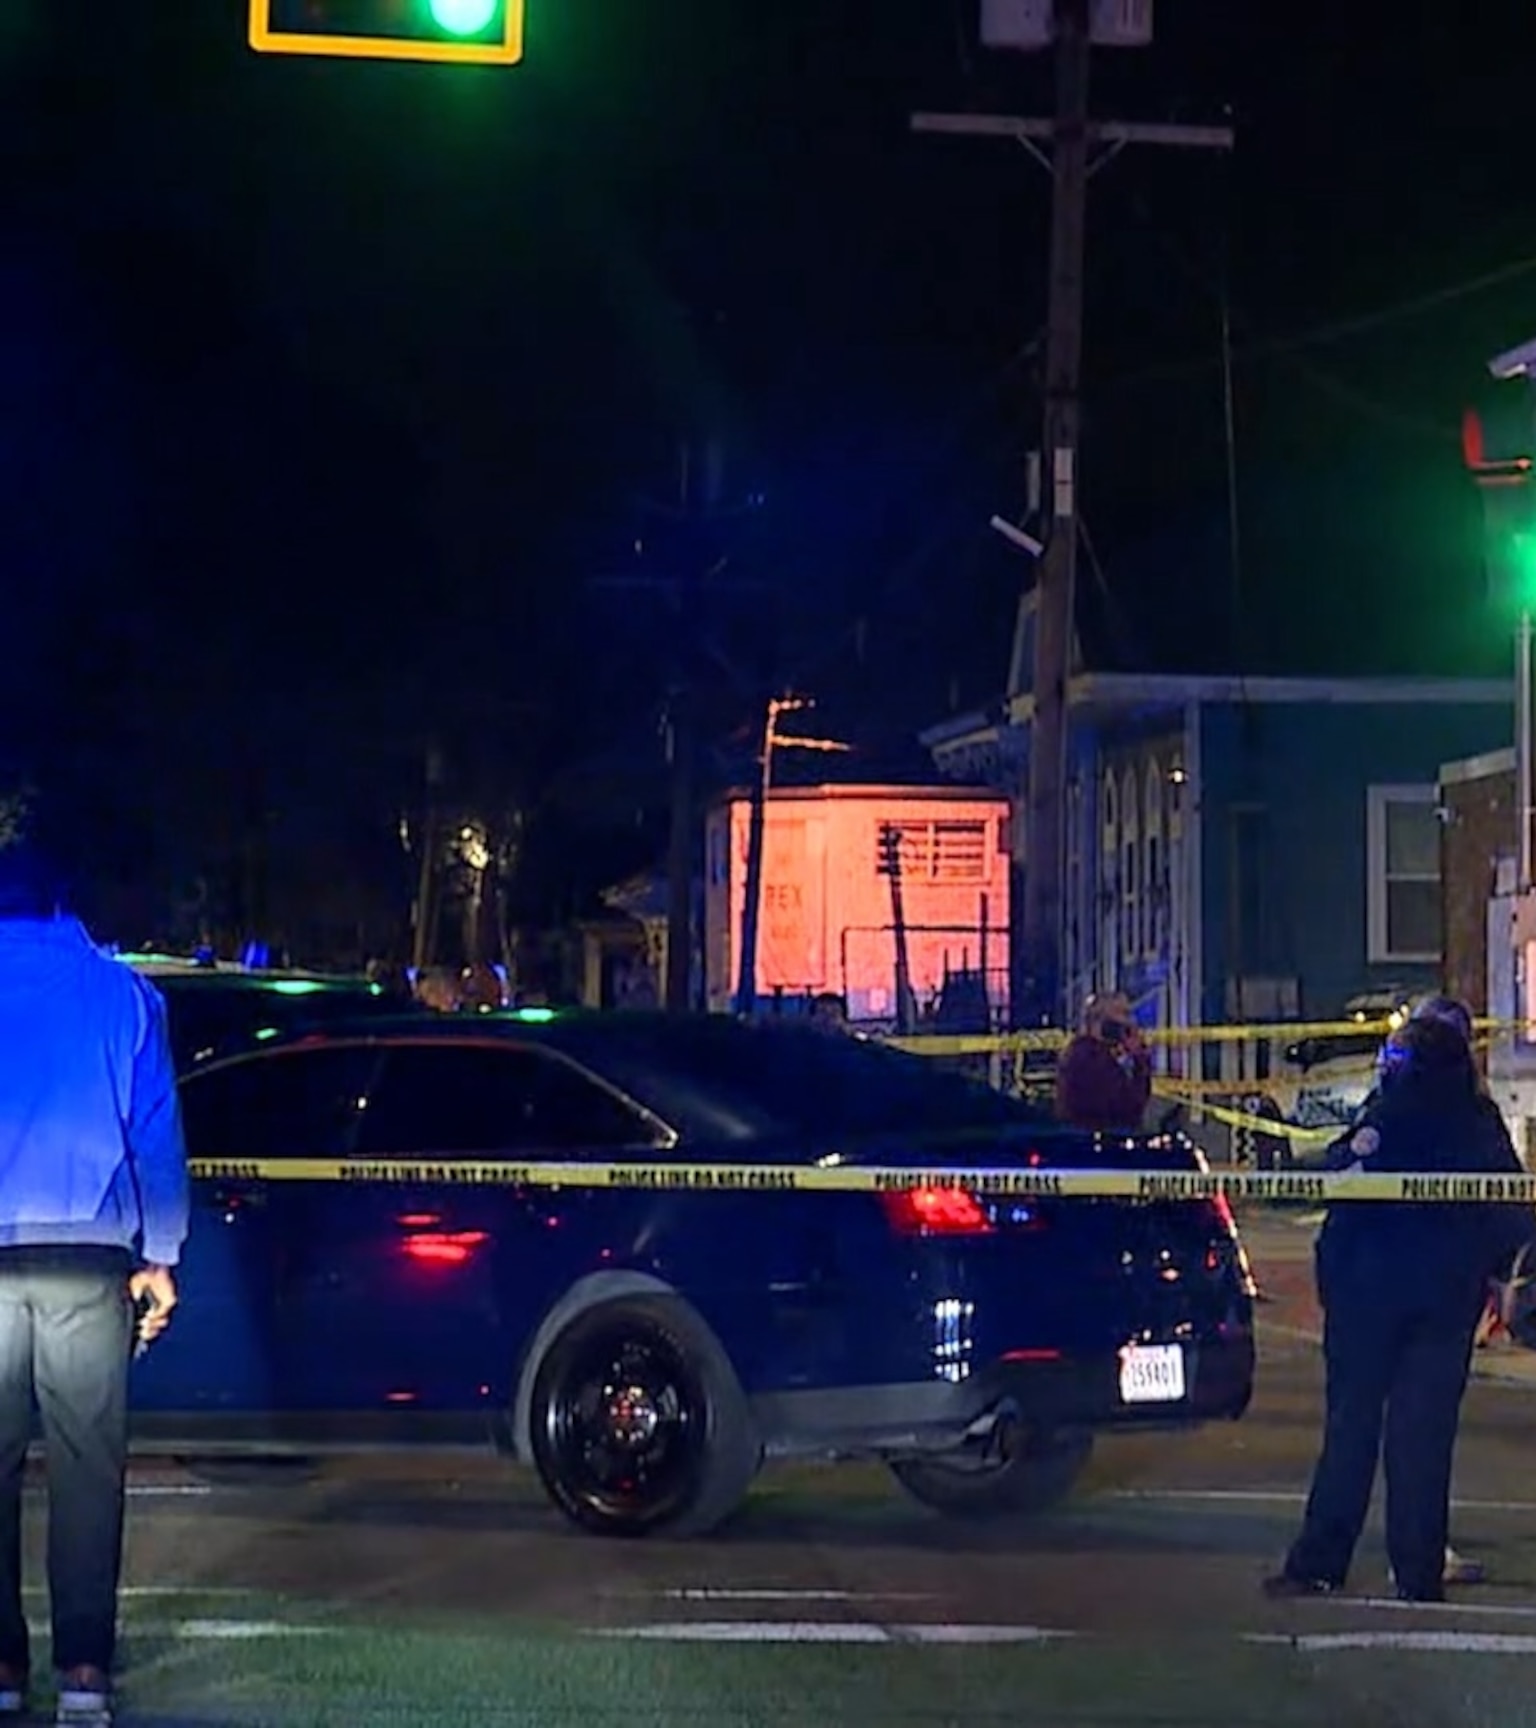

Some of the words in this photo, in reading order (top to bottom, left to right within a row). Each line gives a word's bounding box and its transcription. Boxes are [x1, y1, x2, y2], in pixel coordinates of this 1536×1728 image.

[190, 1163, 207, 1177] OT
[609, 1169, 657, 1185] POLICE
[660, 1169, 690, 1186] LINE
[694, 1170, 713, 1186] DO
[717, 1170, 744, 1187] NOT
[748, 1170, 796, 1187] CROSS
[1138, 1177, 1186, 1194] POLICE
[1190, 1177, 1219, 1194] LINE
[1246, 1178, 1273, 1195] NOT
[1402, 1178, 1449, 1198] POLICE
[1453, 1178, 1482, 1198] LINE
[1509, 1178, 1536, 1199] NOT
